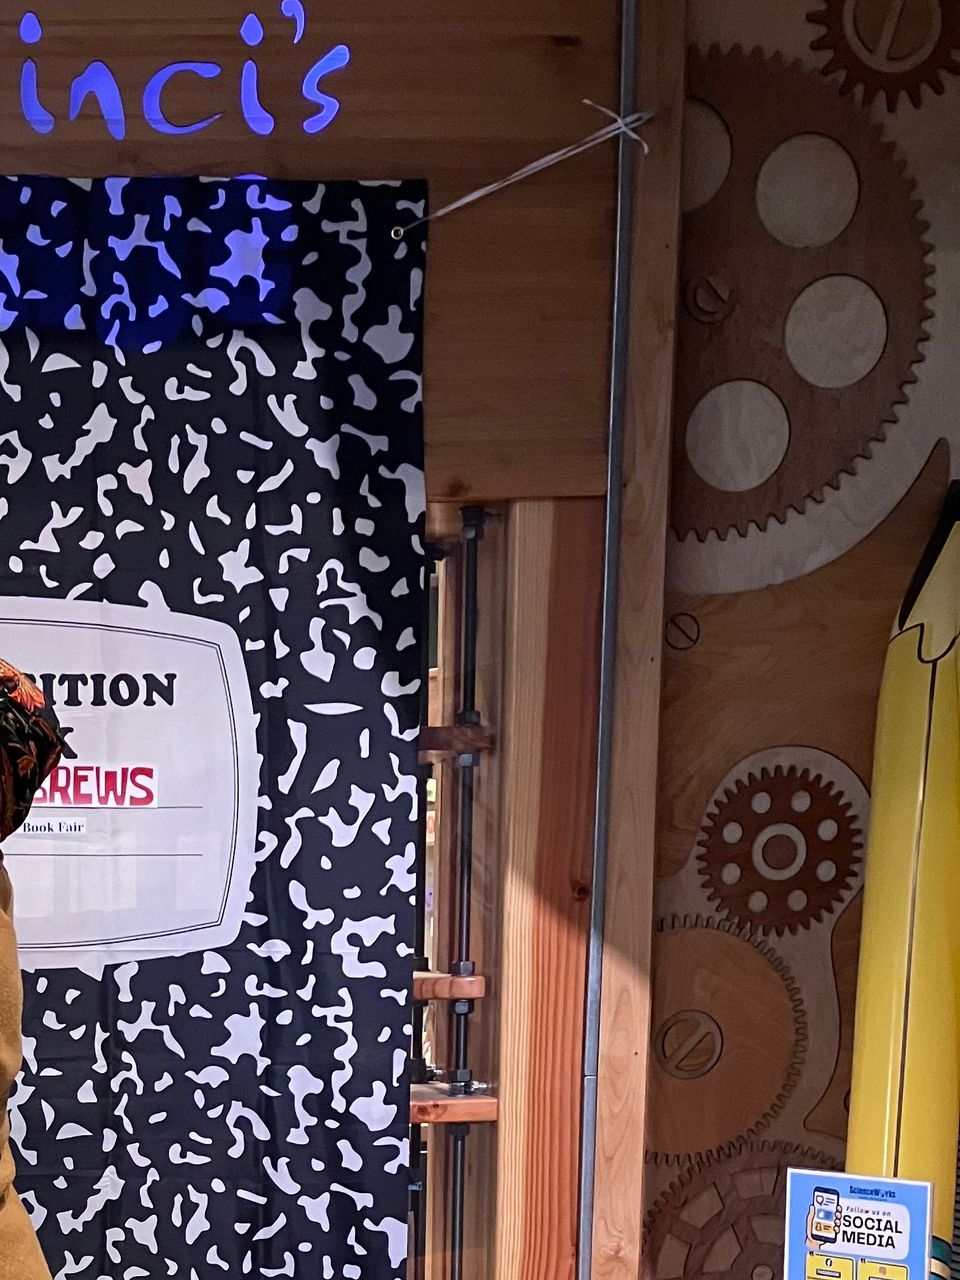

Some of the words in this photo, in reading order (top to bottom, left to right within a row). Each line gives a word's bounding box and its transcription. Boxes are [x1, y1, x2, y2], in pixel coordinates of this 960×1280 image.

[23, 822, 54, 833] Book
[59, 822, 85, 833] Fair
[846, 1206, 869, 1214] Follow
[843, 1215, 902, 1234] SOCIAL
[842, 1230, 895, 1249] MEDIA
